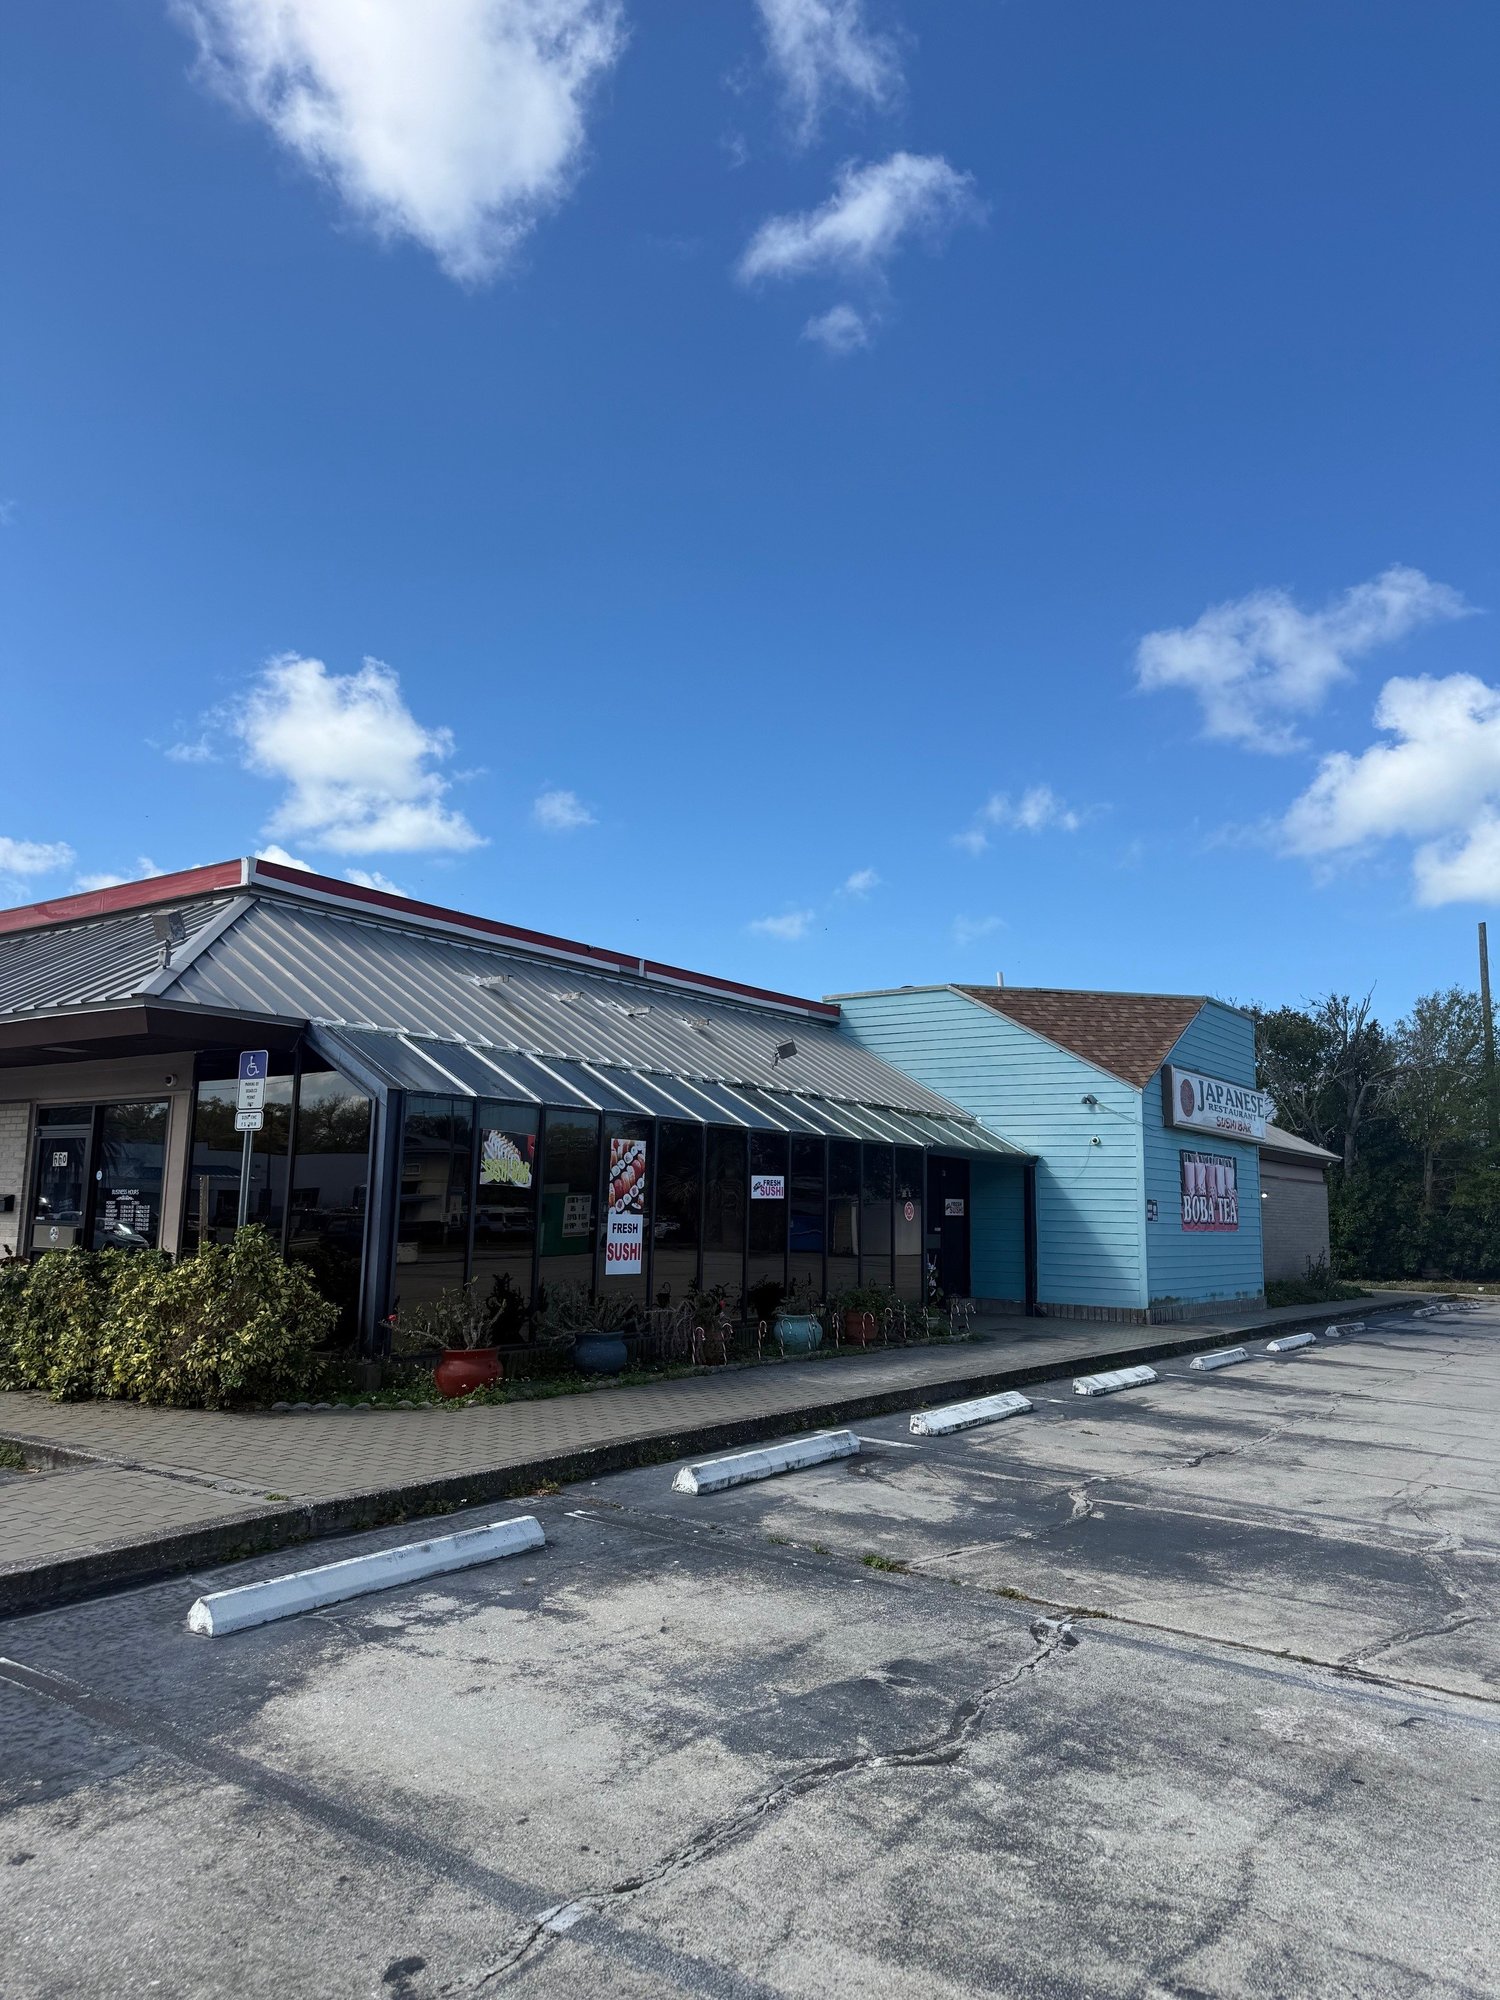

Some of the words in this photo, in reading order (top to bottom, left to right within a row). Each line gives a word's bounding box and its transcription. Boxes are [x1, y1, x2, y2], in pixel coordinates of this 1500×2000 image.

[1198, 1081, 1264, 1118] JAPANESE
[1208, 1103, 1256, 1121] RESTAURANT
[1237, 1121, 1252, 1134] BAR
[54, 1153, 66, 1166] 660
[760, 1187, 784, 1196] SUSHI
[1183, 1195, 1215, 1222] BOBA
[1218, 1197, 1238, 1223] TEA
[612, 1223, 638, 1234] FRESH
[607, 1243, 641, 1261] SUSHI
